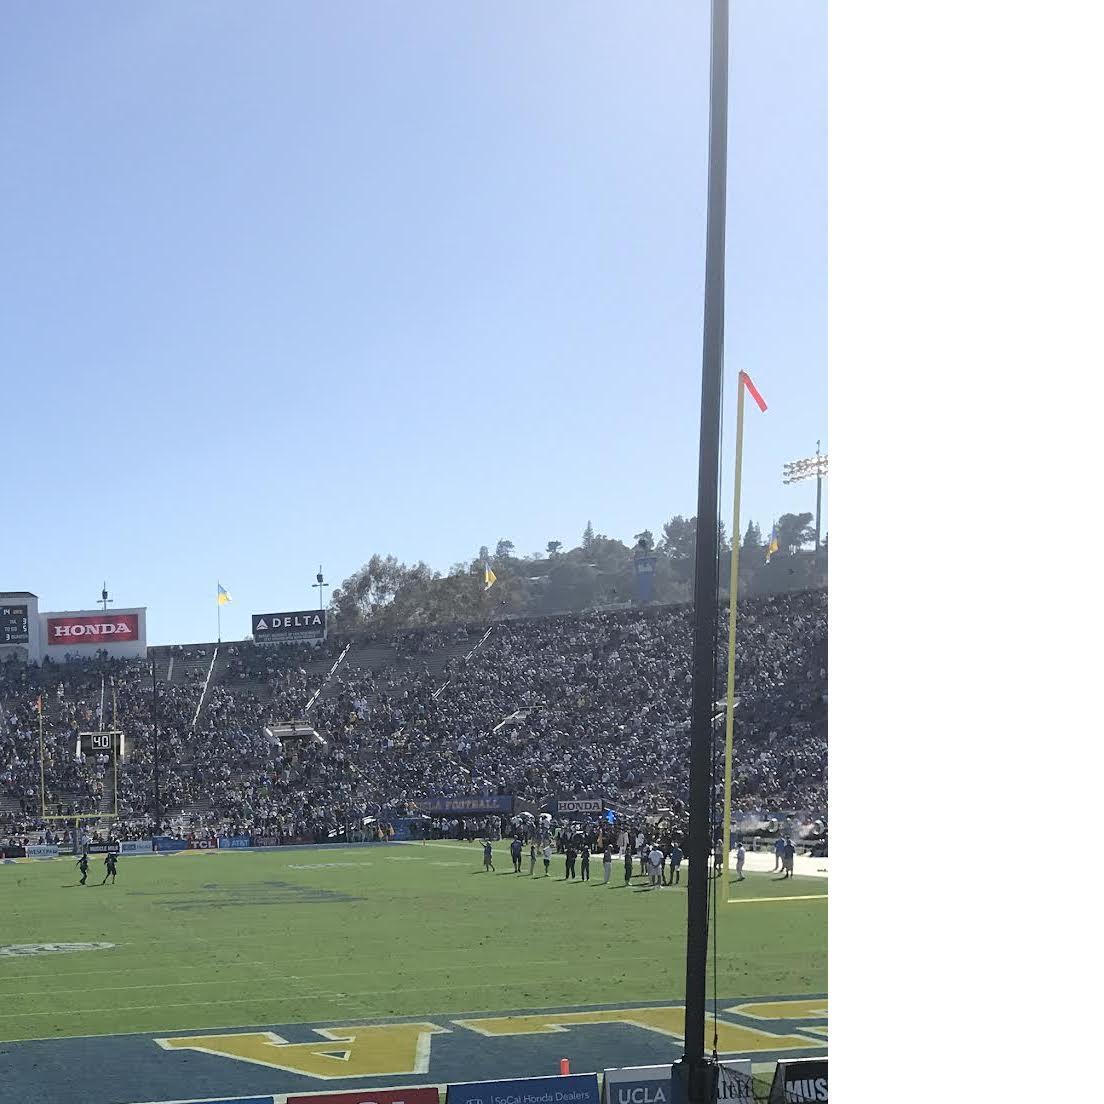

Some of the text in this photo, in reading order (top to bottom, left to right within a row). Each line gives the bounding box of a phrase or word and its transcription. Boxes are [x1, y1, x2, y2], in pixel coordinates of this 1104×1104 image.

[272, 615, 321, 628] DELTA
[54, 623, 131, 636] HONDA
[93, 735, 109, 747] 40
[559, 801, 601, 811] HONDA
[191, 840, 216, 848] TCL
[523, 1093, 554, 1104] Honda
[555, 1091, 590, 1101] Dealers
[618, 1087, 667, 1104] UCLA
